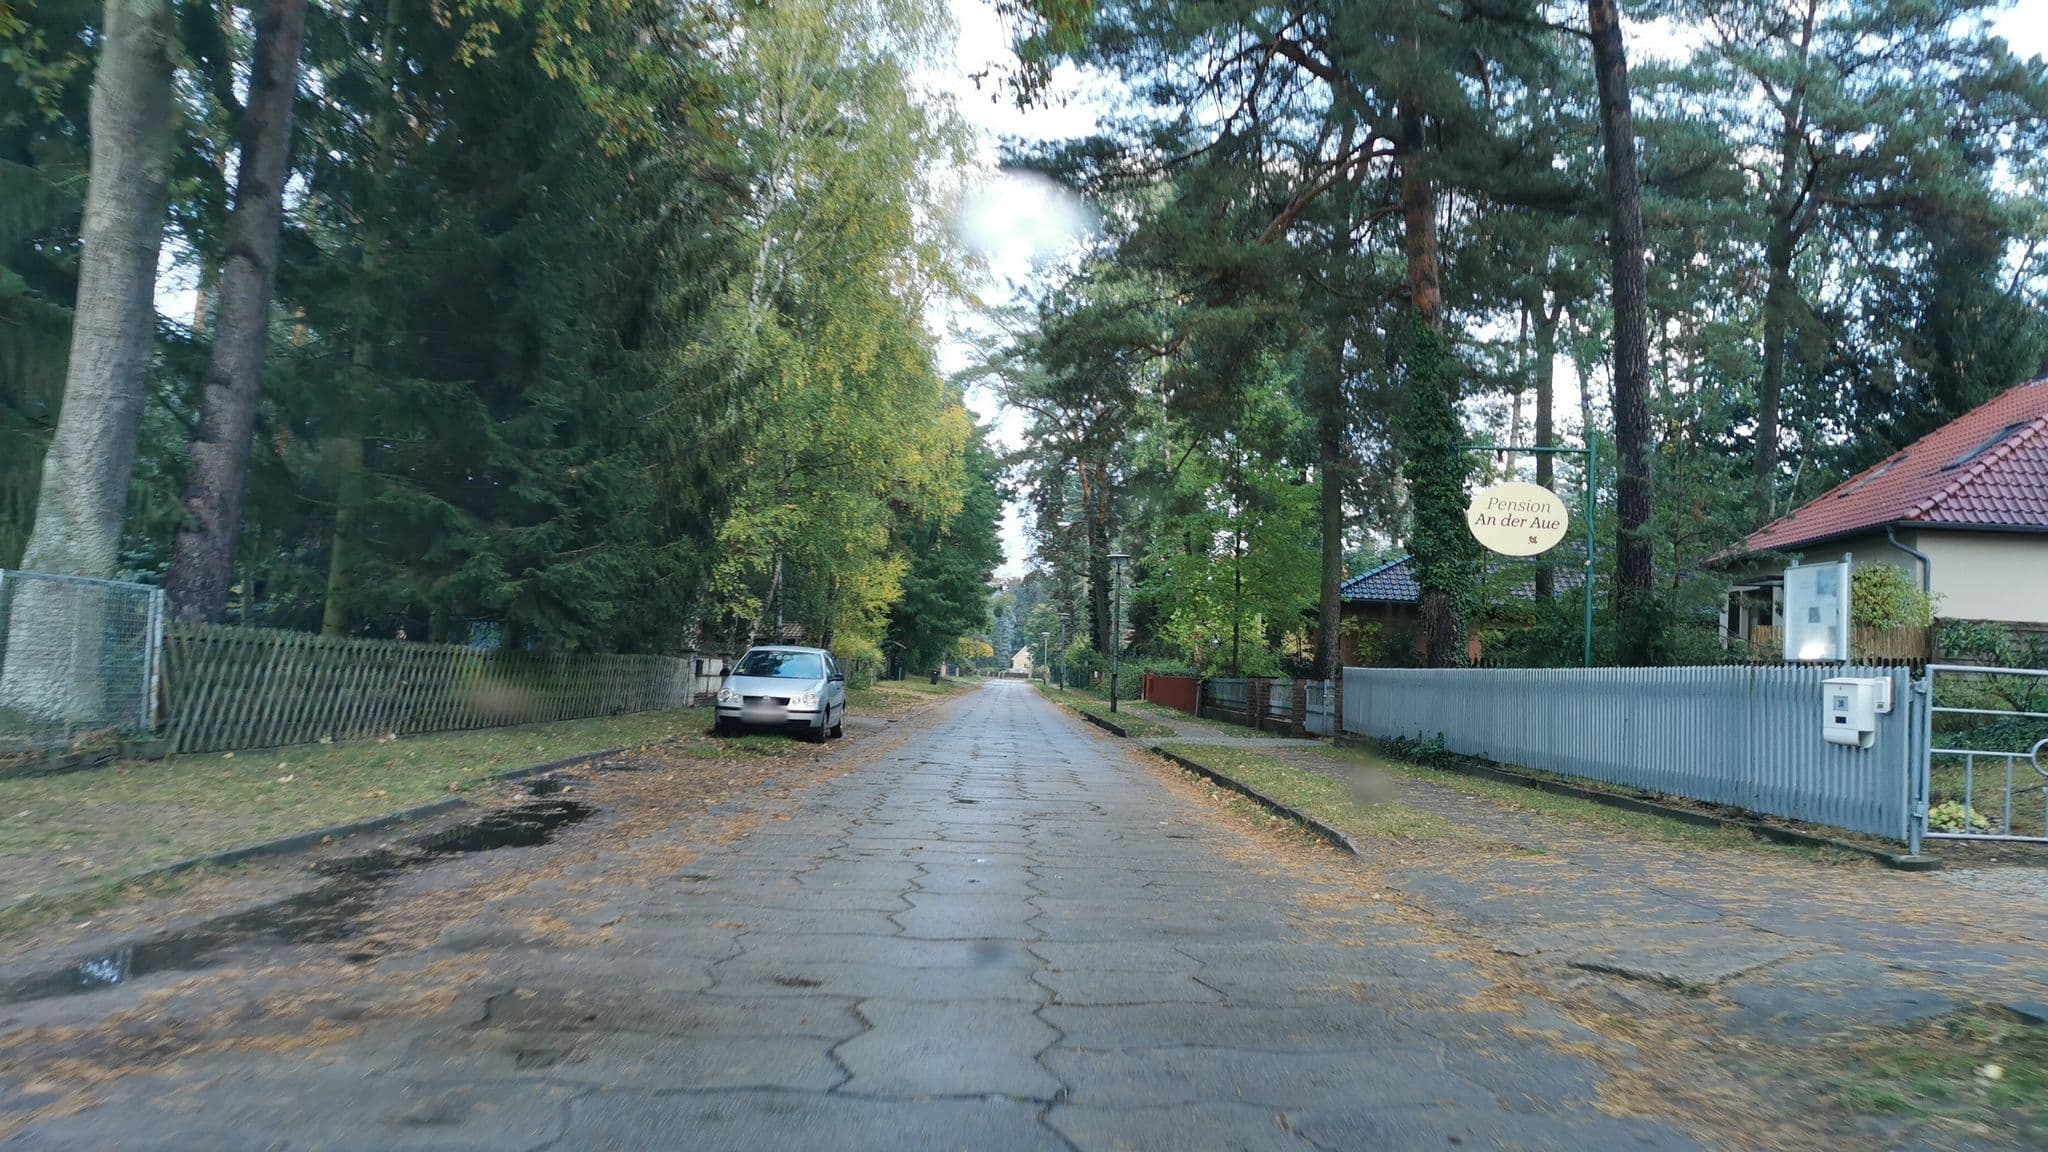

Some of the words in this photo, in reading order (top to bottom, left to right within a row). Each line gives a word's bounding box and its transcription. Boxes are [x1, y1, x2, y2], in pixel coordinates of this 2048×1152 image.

[1488, 497, 1551, 513] Pension
[1475, 513, 1496, 526] An
[1501, 513, 1527, 527] der
[1530, 517, 1560, 530] Aue
